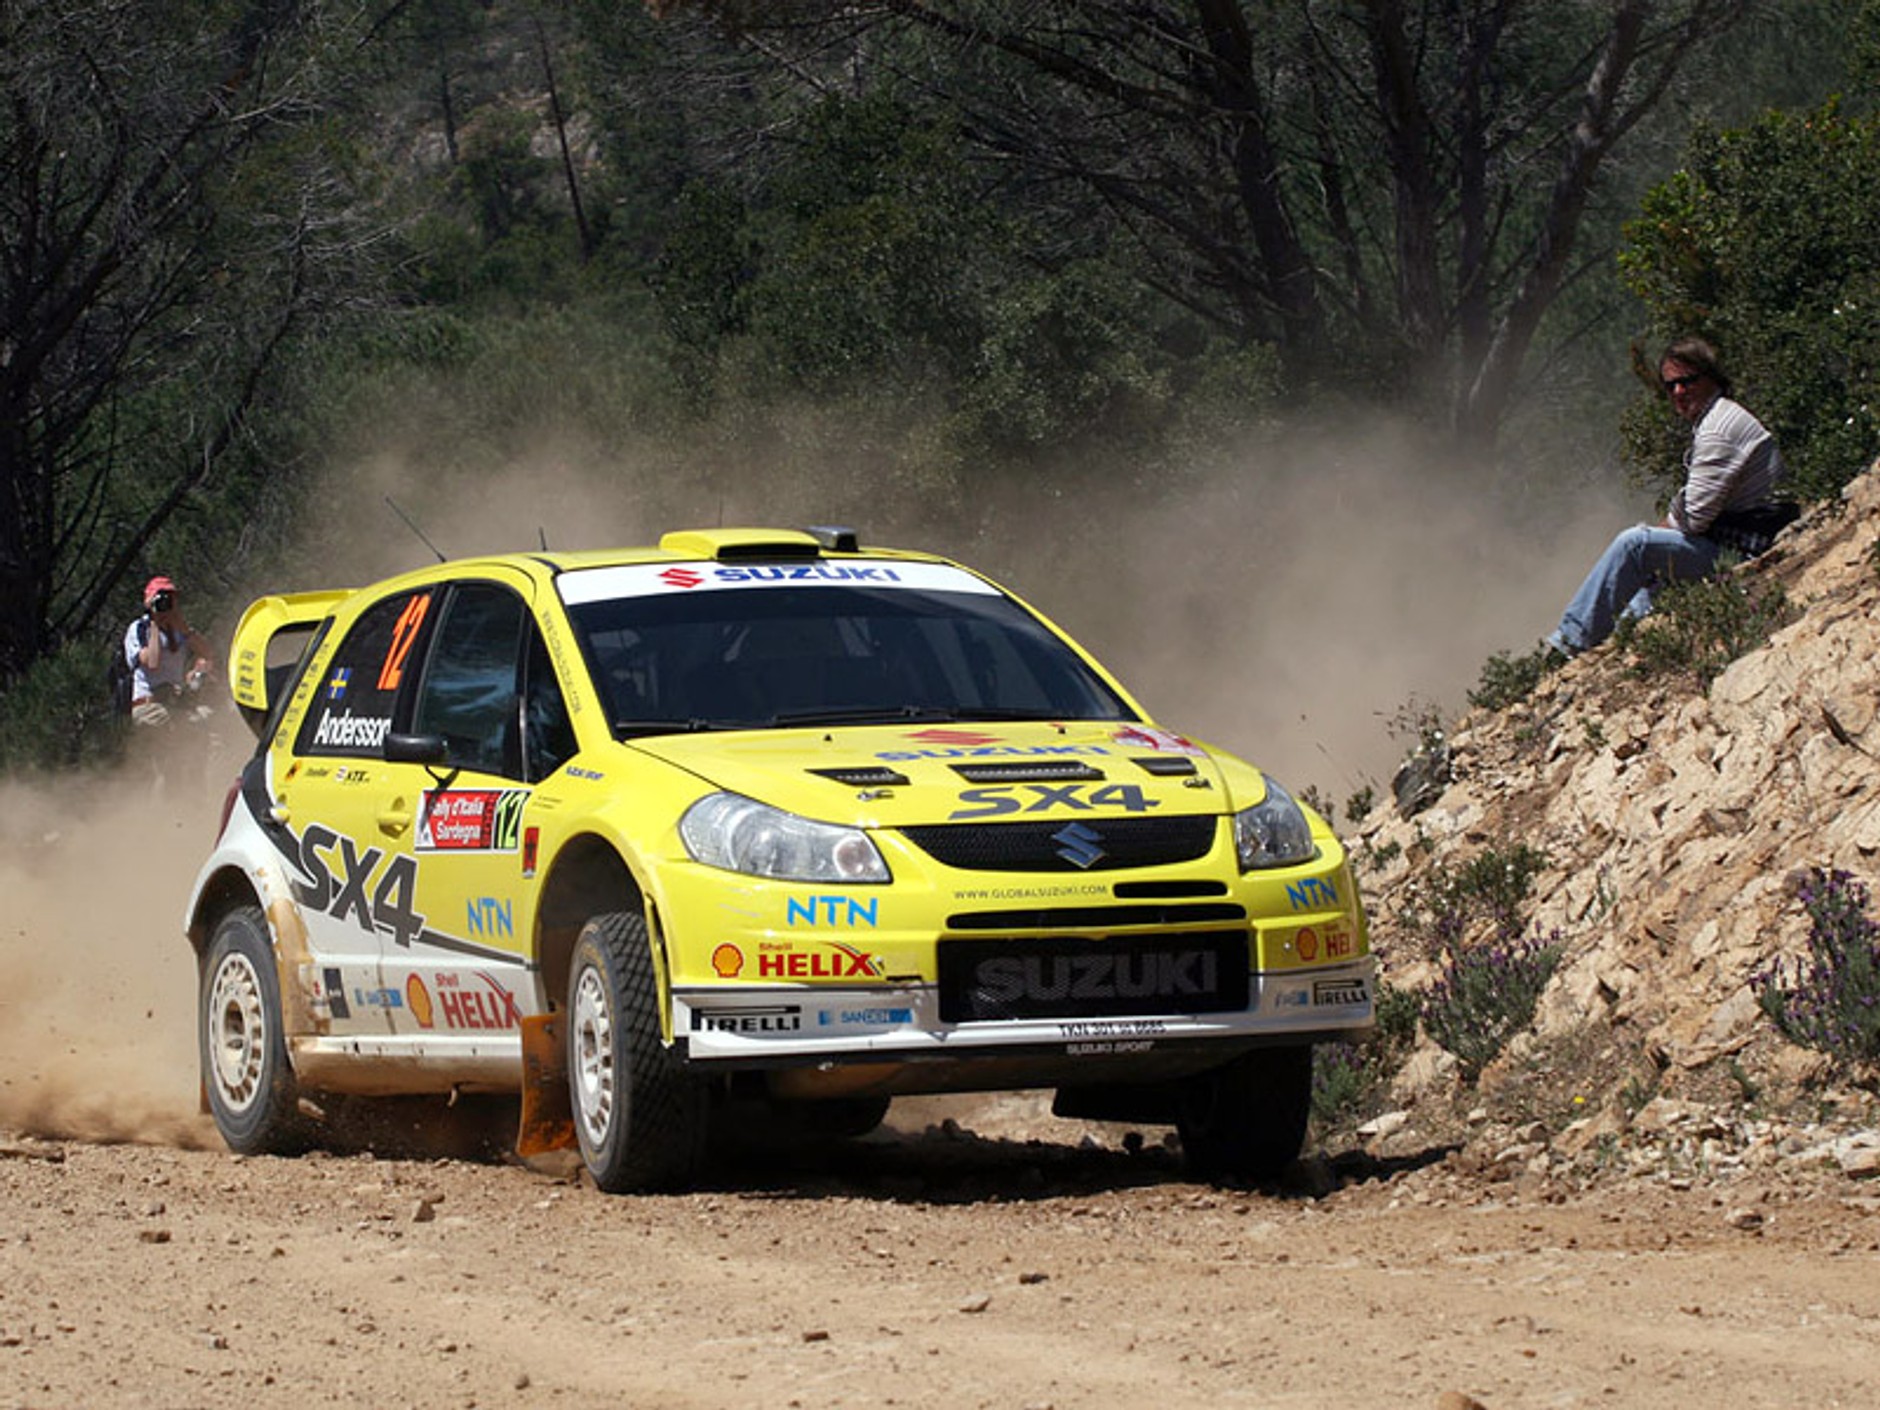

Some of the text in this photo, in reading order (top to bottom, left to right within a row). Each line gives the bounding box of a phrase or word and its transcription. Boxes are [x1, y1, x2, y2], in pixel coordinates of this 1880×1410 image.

[714, 566, 902, 582] SUZUKI
[376, 594, 430, 690] 12
[875, 745, 1111, 761] SUZUKI
[947, 784, 1161, 821] SX4
[436, 819, 481, 845] Sardegna
[497, 791, 529, 849] 12
[290, 824, 424, 948] SX4
[1284, 876, 1338, 911] NTN
[467, 896, 513, 939] NTN
[787, 896, 878, 927] NTN
[435, 972, 459, 988] Shell
[758, 952, 878, 977] HELIX
[975, 950, 1217, 1003] SUZUKI
[438, 990, 522, 1029] HELIX
[690, 1005, 802, 1032] PIRELLI
[1114, 1040, 1154, 1053] SPORT
